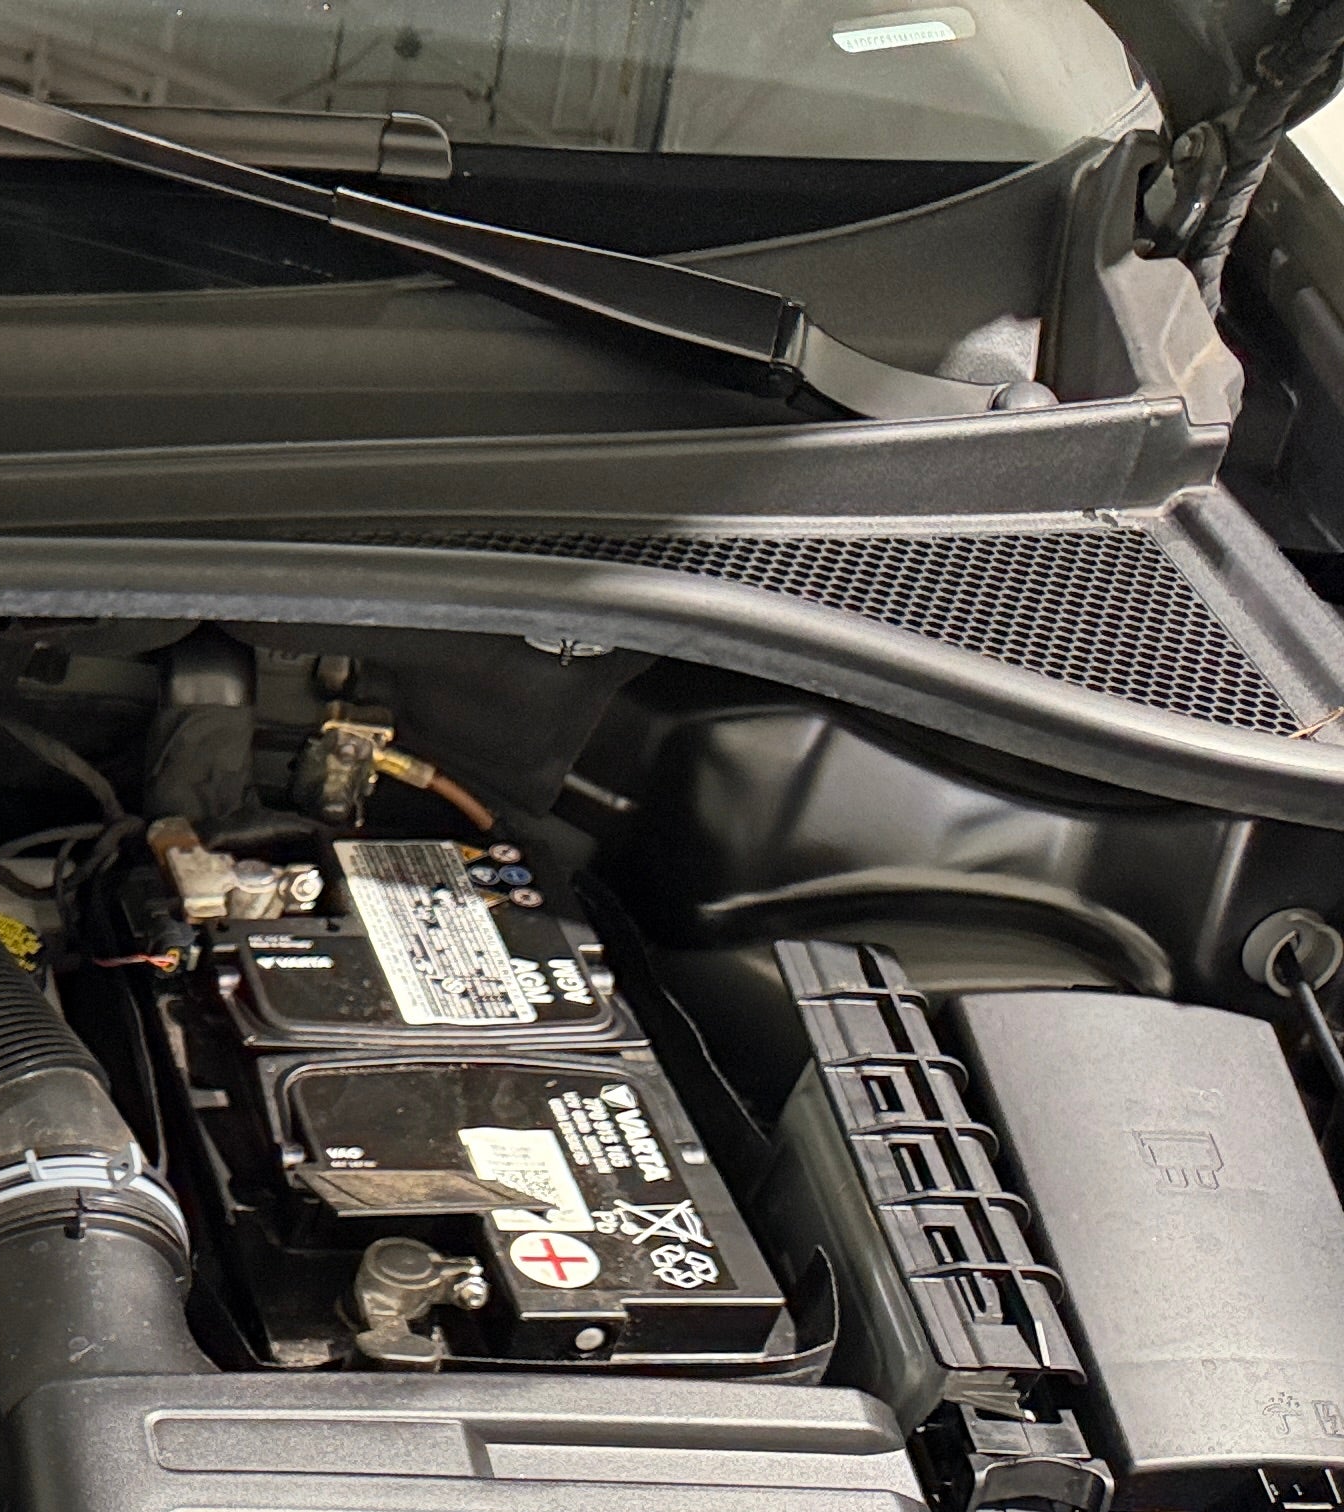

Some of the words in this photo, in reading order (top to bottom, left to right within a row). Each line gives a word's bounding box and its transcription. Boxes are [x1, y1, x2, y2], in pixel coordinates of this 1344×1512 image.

[509, 957, 555, 1004] AGM
[548, 958, 595, 1006] AGM
[615, 1107, 672, 1182] VARTA
[591, 1210, 619, 1235] Pb
